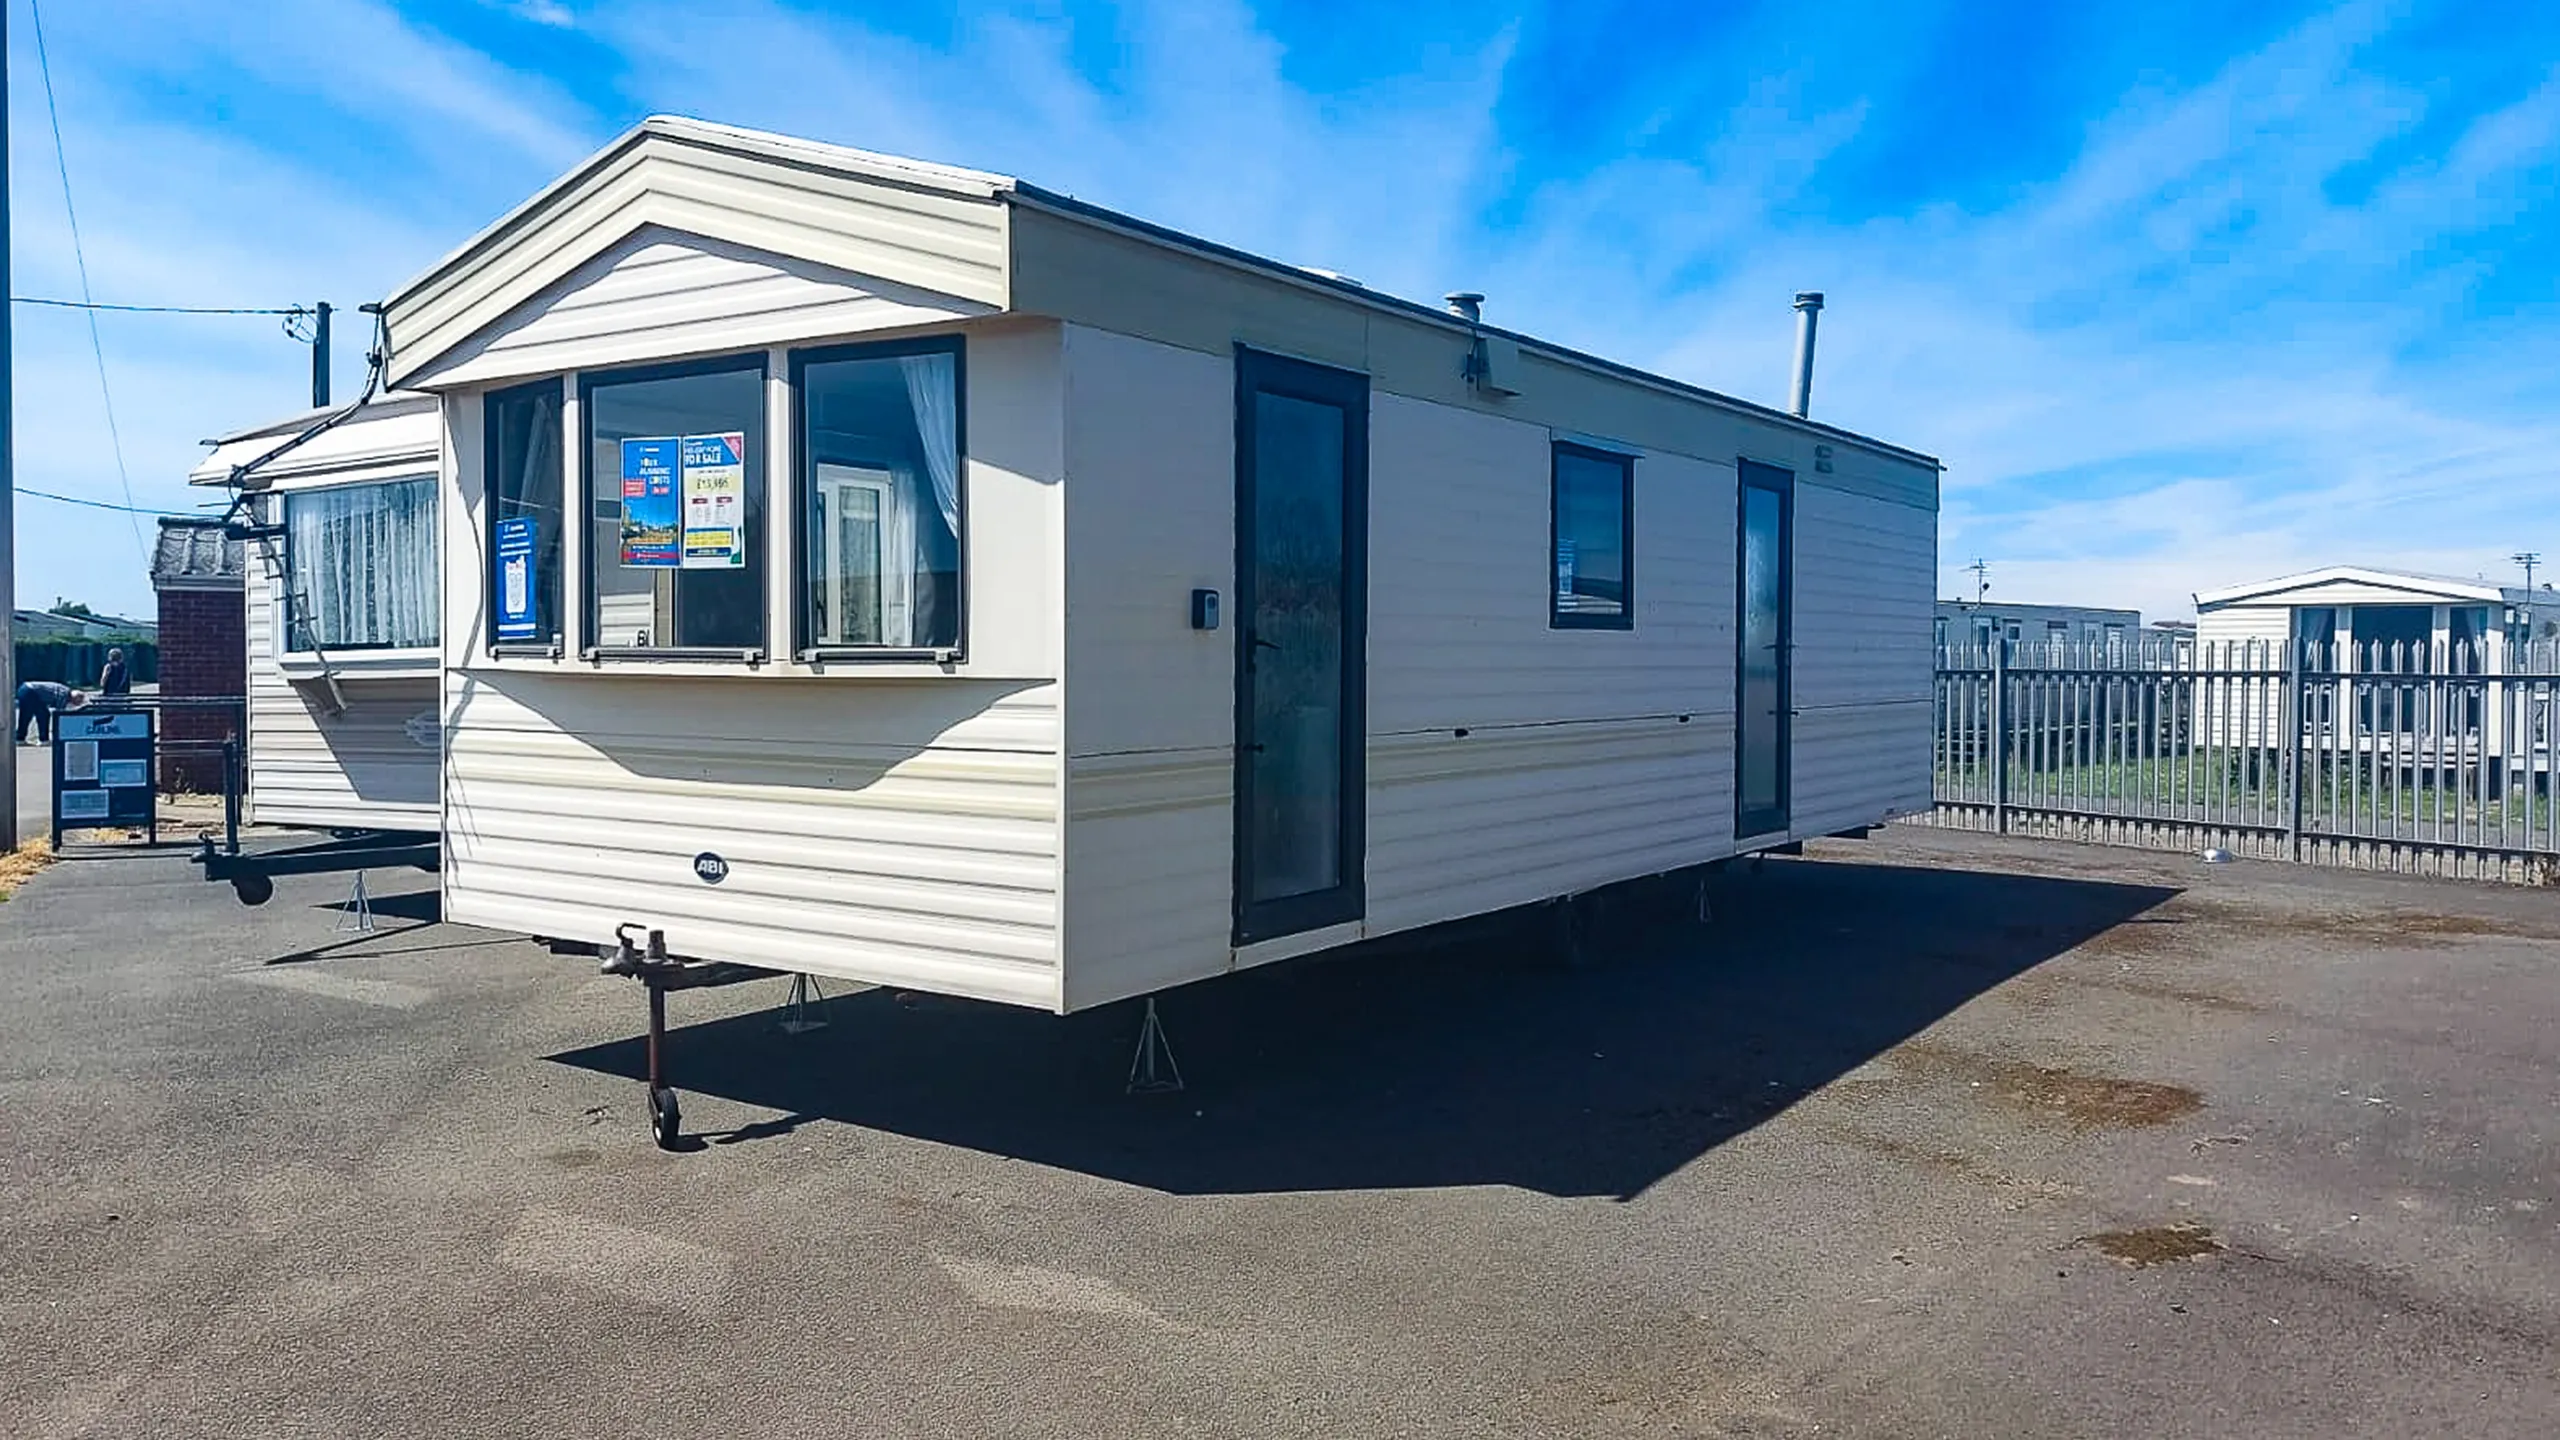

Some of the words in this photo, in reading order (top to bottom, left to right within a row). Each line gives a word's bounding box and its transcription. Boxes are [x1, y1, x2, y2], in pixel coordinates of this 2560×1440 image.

[685, 454, 702, 466] FOR
[703, 452, 721, 464] SALE
[697, 860, 723, 874] ABI
